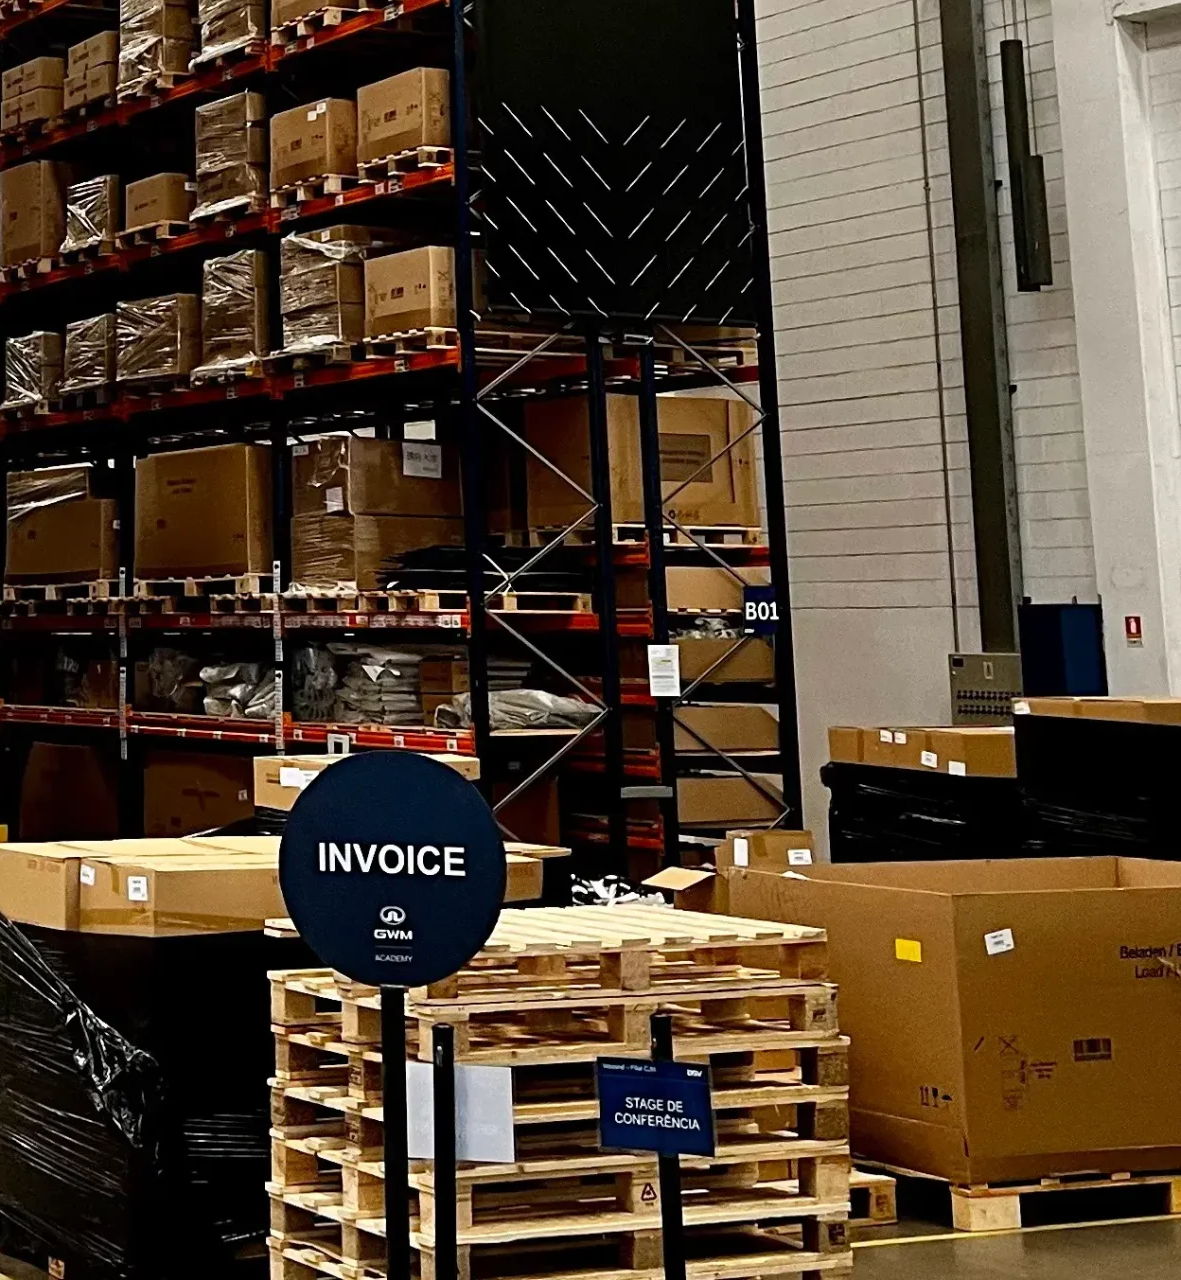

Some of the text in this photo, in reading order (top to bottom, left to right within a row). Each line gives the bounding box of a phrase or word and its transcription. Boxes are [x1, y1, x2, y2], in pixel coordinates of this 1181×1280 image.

[745, 601, 780, 620] B01
[318, 842, 467, 877] INVOICE
[373, 928, 414, 940] GWM
[374, 953, 414, 963] ACADEMY
[624, 1096, 684, 1113] STAGE DE
[614, 1111, 701, 1132] CONFERÊNCIA
